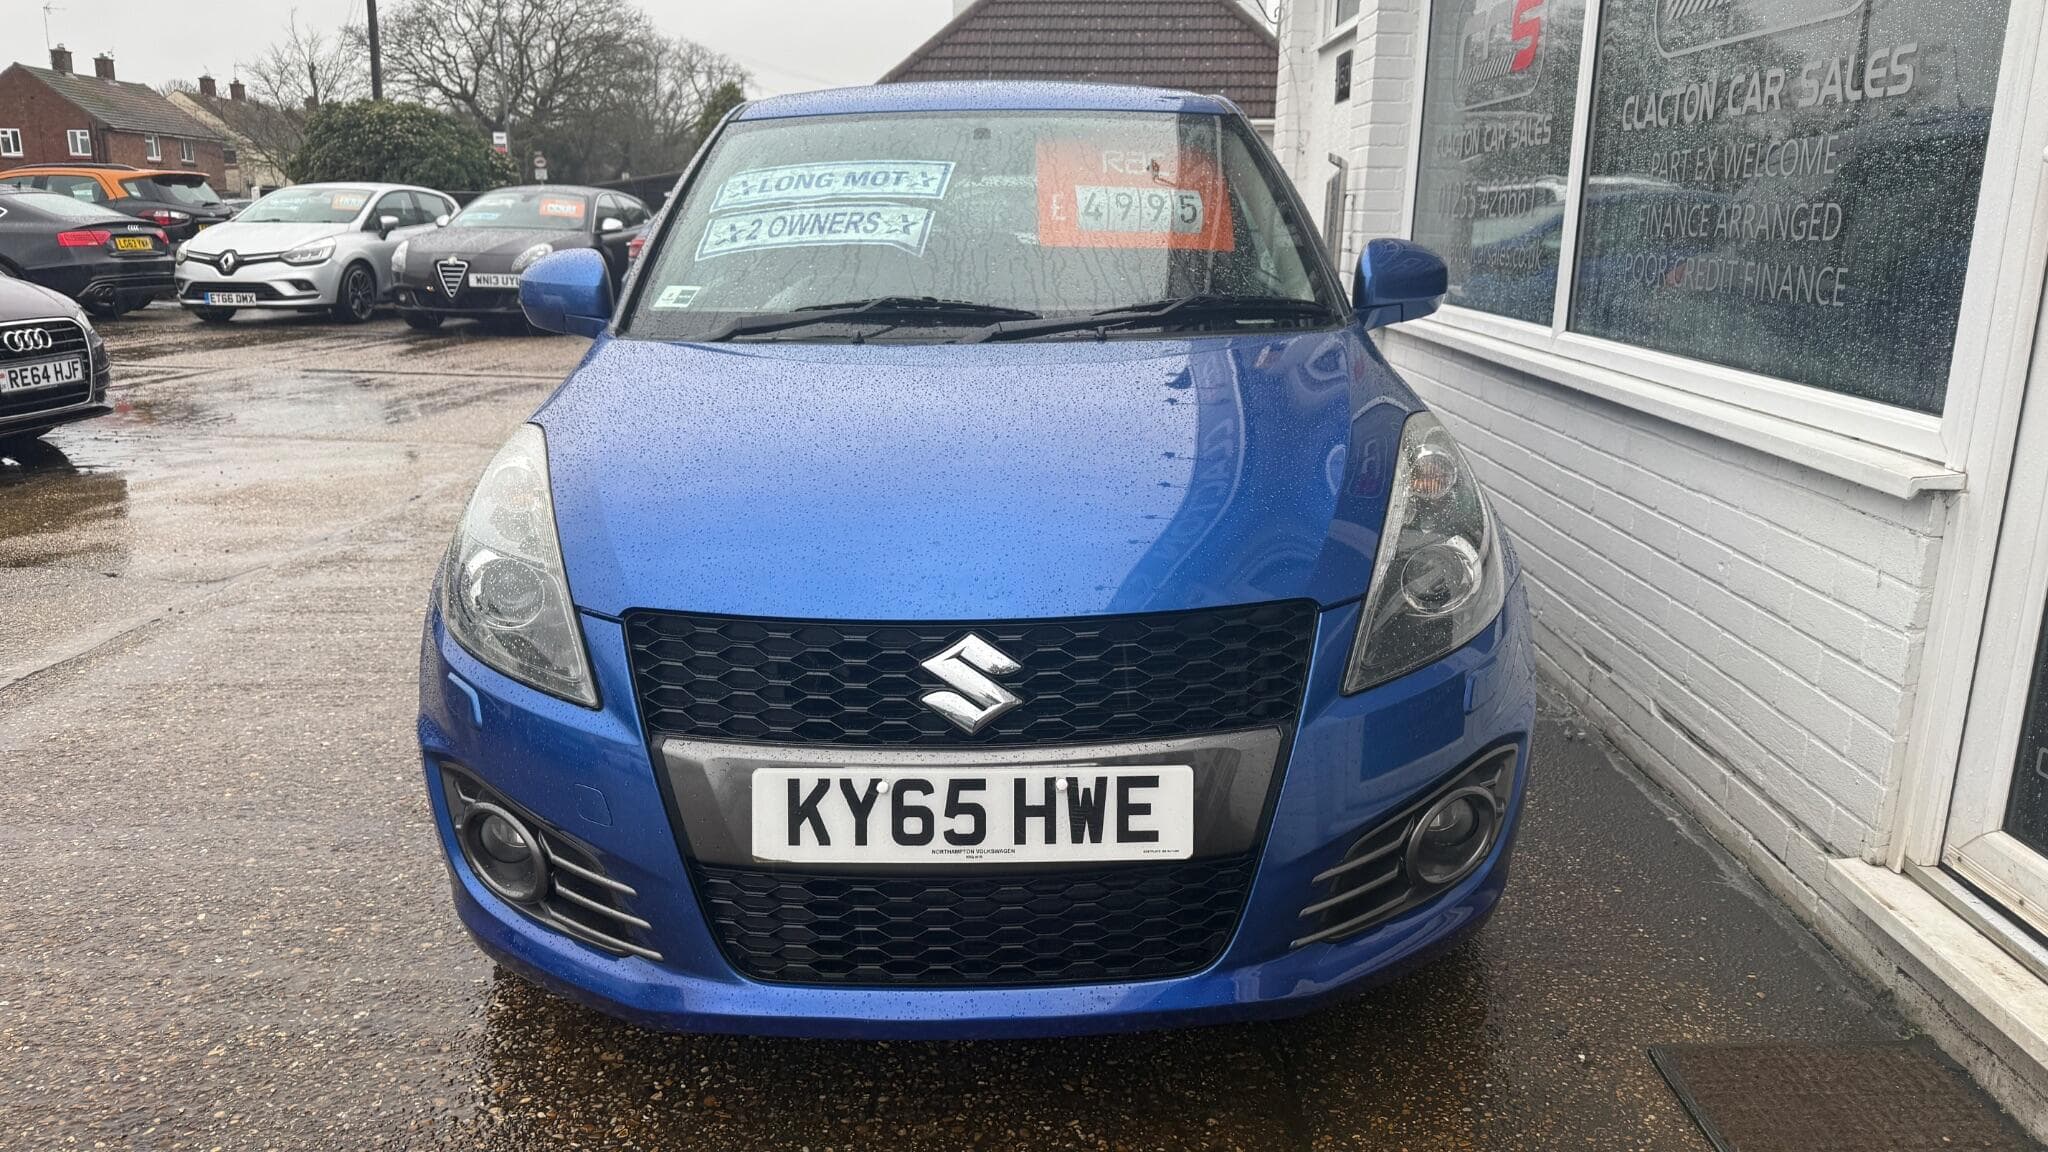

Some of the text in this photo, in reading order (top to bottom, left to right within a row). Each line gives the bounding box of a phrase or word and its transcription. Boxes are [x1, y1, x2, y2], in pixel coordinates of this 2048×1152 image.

[1622, 41, 1918, 131] CLACTON CAR SALES
[1436, 113, 1552, 158] CLACTON CAR SALES
[1651, 134, 1840, 182] PART EX WELCOME
[757, 170, 909, 194] LONG MOT
[1480, 175, 1536, 219] 426661
[745, 211, 882, 240] 2 OWNERS
[1083, 191, 1198, 225] 4995
[1638, 202, 1842, 242] FINANCE ARRANGED
[210, 293, 255, 304] ET66 DMX
[1623, 252, 1849, 307] POOR CREDIT FINANCE
[8, 360, 79, 389] RE64 HJF
[787, 775, 1160, 846] KY65 HWE
